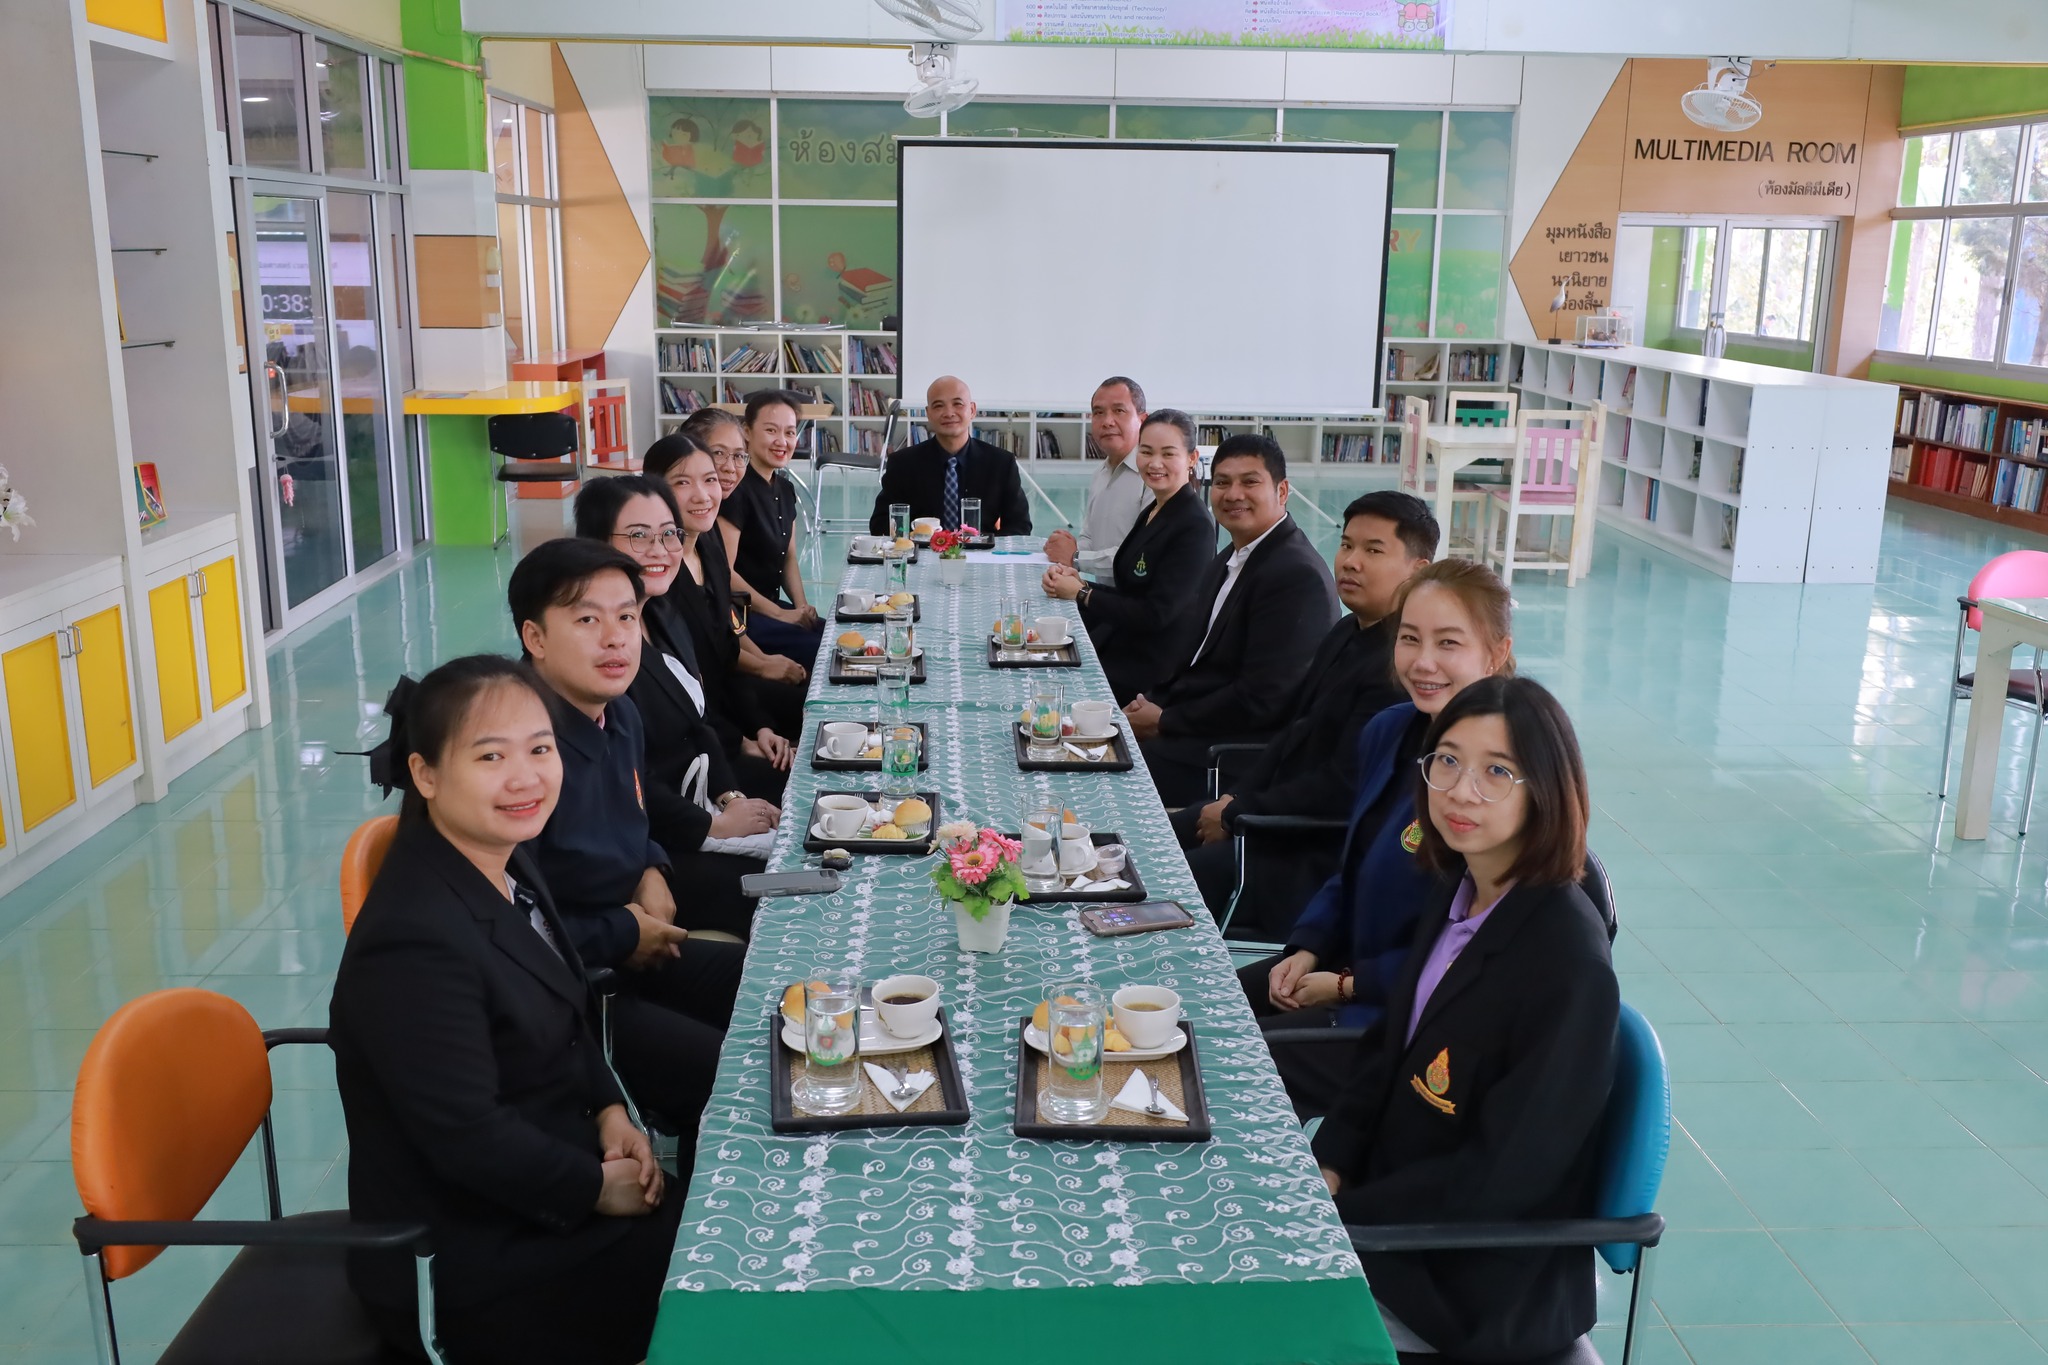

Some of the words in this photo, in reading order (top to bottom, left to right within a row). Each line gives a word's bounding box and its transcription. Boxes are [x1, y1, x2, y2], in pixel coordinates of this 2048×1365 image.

[1634, 139, 1775, 163] MULTIMEDIA
[1787, 142, 1857, 165] ROOM
[1546, 222, 1611, 244] มุมหนังสือ
[1559, 251, 1609, 263] เยาวชน
